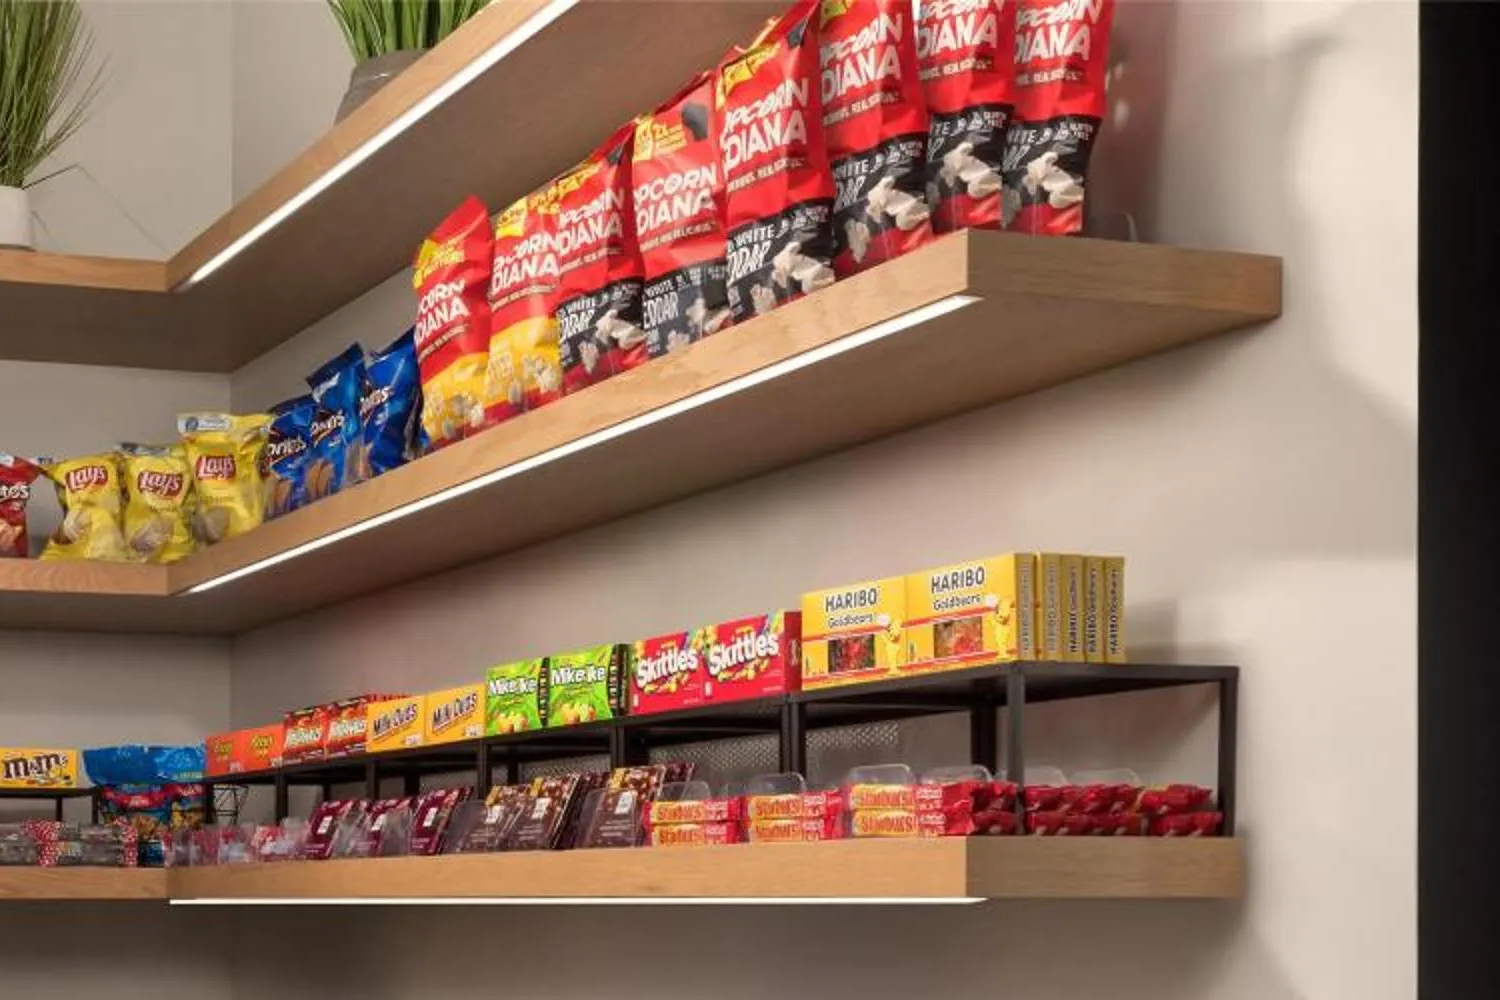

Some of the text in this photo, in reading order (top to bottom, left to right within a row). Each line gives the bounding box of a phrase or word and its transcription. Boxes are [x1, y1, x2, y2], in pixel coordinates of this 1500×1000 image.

[931, 565, 985, 594] HARIBO
[825, 587, 877, 613] HARIBO
[637, 646, 699, 689] Skittles
[708, 628, 780, 676] Skittles
